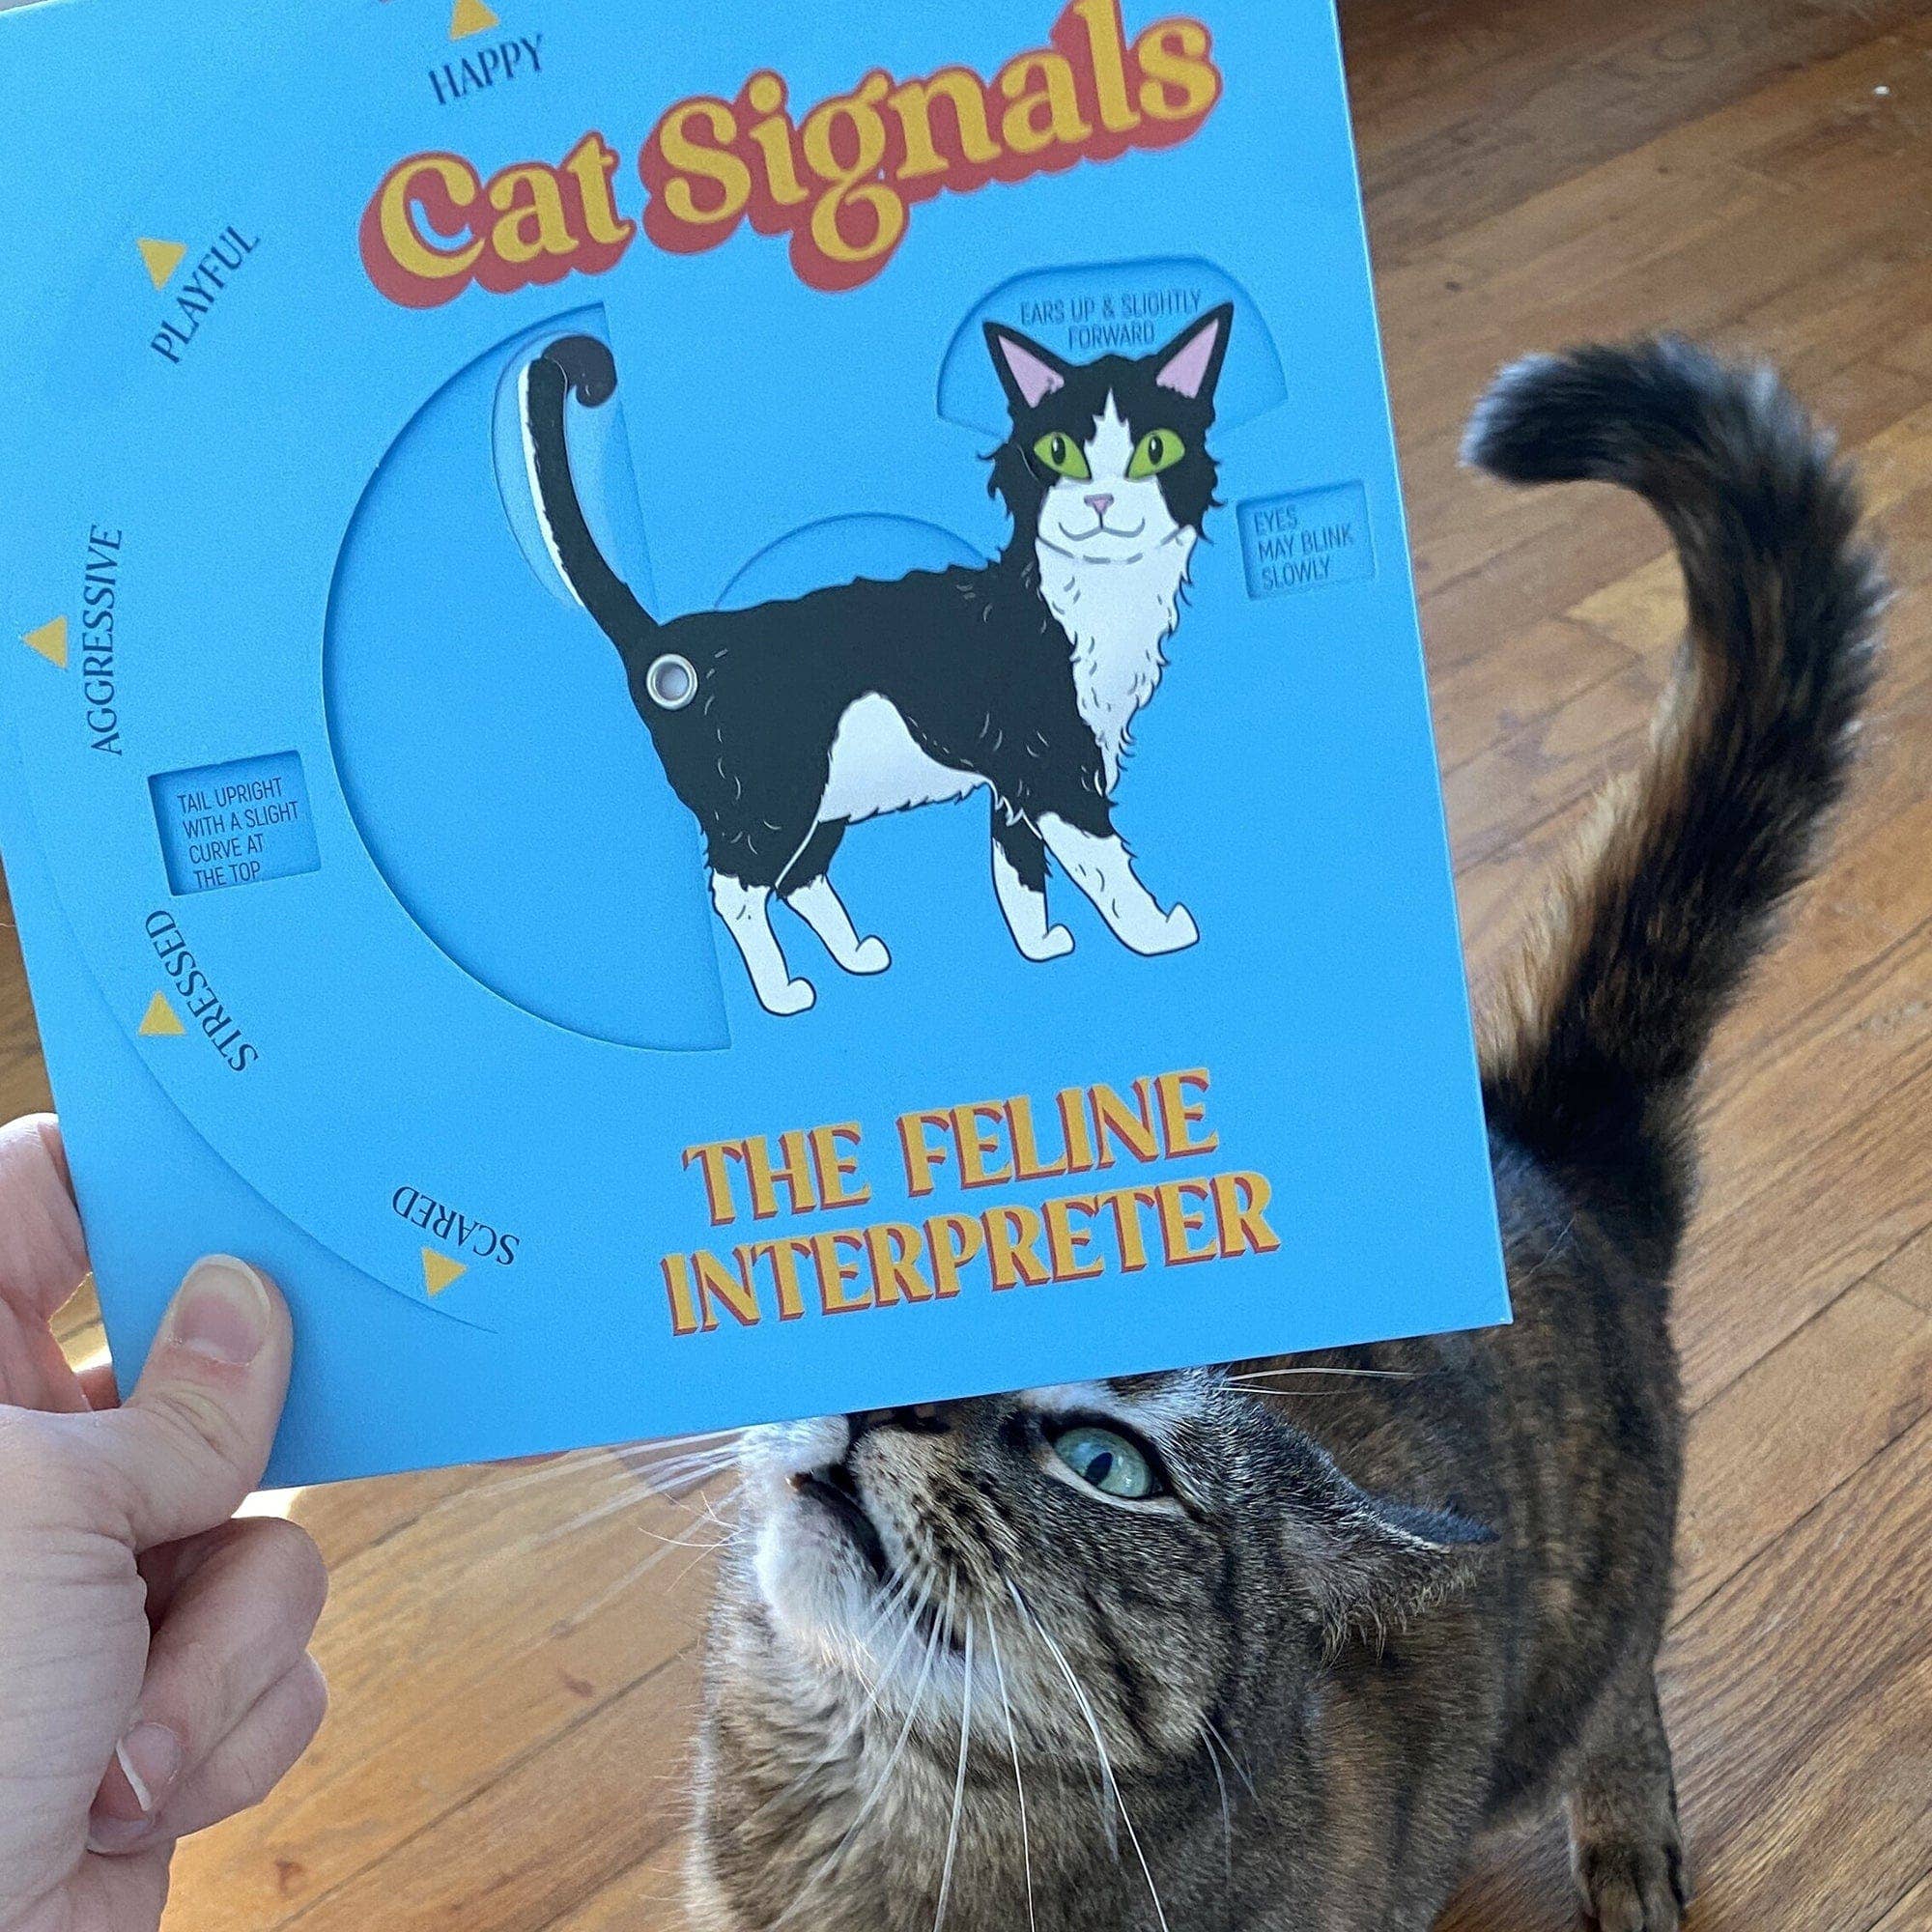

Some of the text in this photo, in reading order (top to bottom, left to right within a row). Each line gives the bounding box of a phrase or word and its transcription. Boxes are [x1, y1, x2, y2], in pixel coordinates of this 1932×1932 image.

[428, 34, 547, 106] HAPPY
[358, 0, 1224, 309] Cat Signals
[150, 225, 261, 364] PLAYFUL
[1020, 289, 1201, 326] EARS UP & SLIGHTLY
[1067, 321, 1155, 350] FORWARD
[1254, 505, 1299, 531] EYES
[1259, 523, 1353, 560] MAY BLINK
[1262, 556, 1329, 591] SLOWLY
[82, 523, 123, 757] AGGRESSIVE
[178, 778, 282, 814] TAIL UPRIGHT
[183, 800, 299, 839] WITH A SLIGHT
[189, 833, 266, 864] CURVE AT
[195, 861, 261, 889] THE TOP
[144, 910, 259, 1073] STRESSED
[682, 1067, 1220, 1226] THE FELINE
[392, 1184, 521, 1266] SCARED
[661, 1171, 1281, 1336] INTERPRETER
